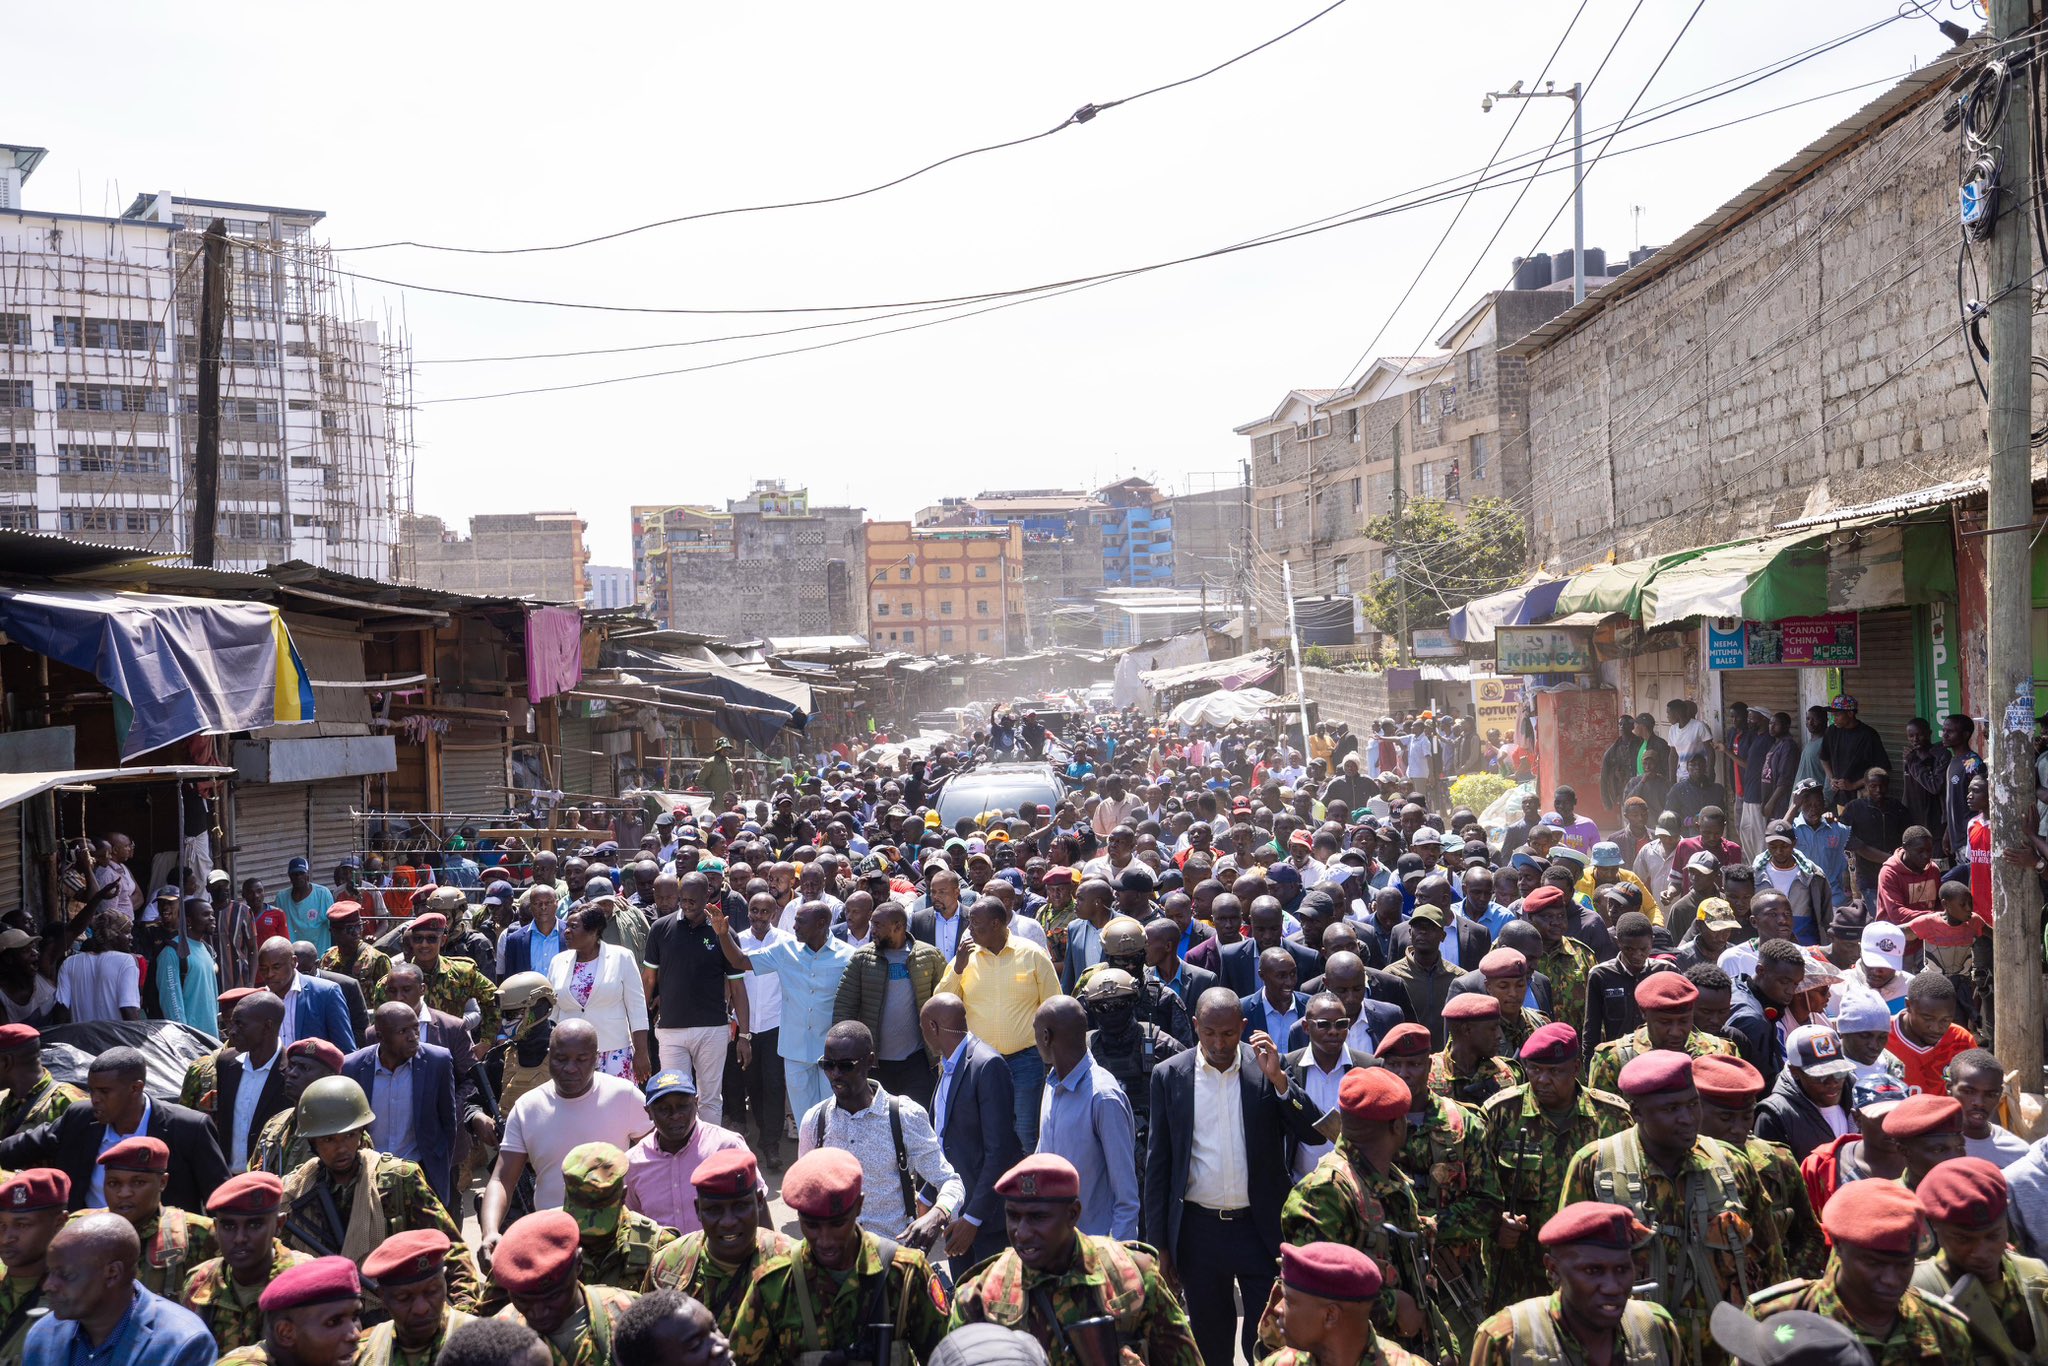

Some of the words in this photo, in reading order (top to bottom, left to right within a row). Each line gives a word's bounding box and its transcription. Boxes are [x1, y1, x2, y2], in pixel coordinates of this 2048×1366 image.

[1789, 626, 1829, 634] CANADA
[1789, 637, 1819, 645] CHINA
[1789, 647, 1803, 655] UK
[1715, 657, 1737, 665] BALES
[167, 965, 178, 991] simply
